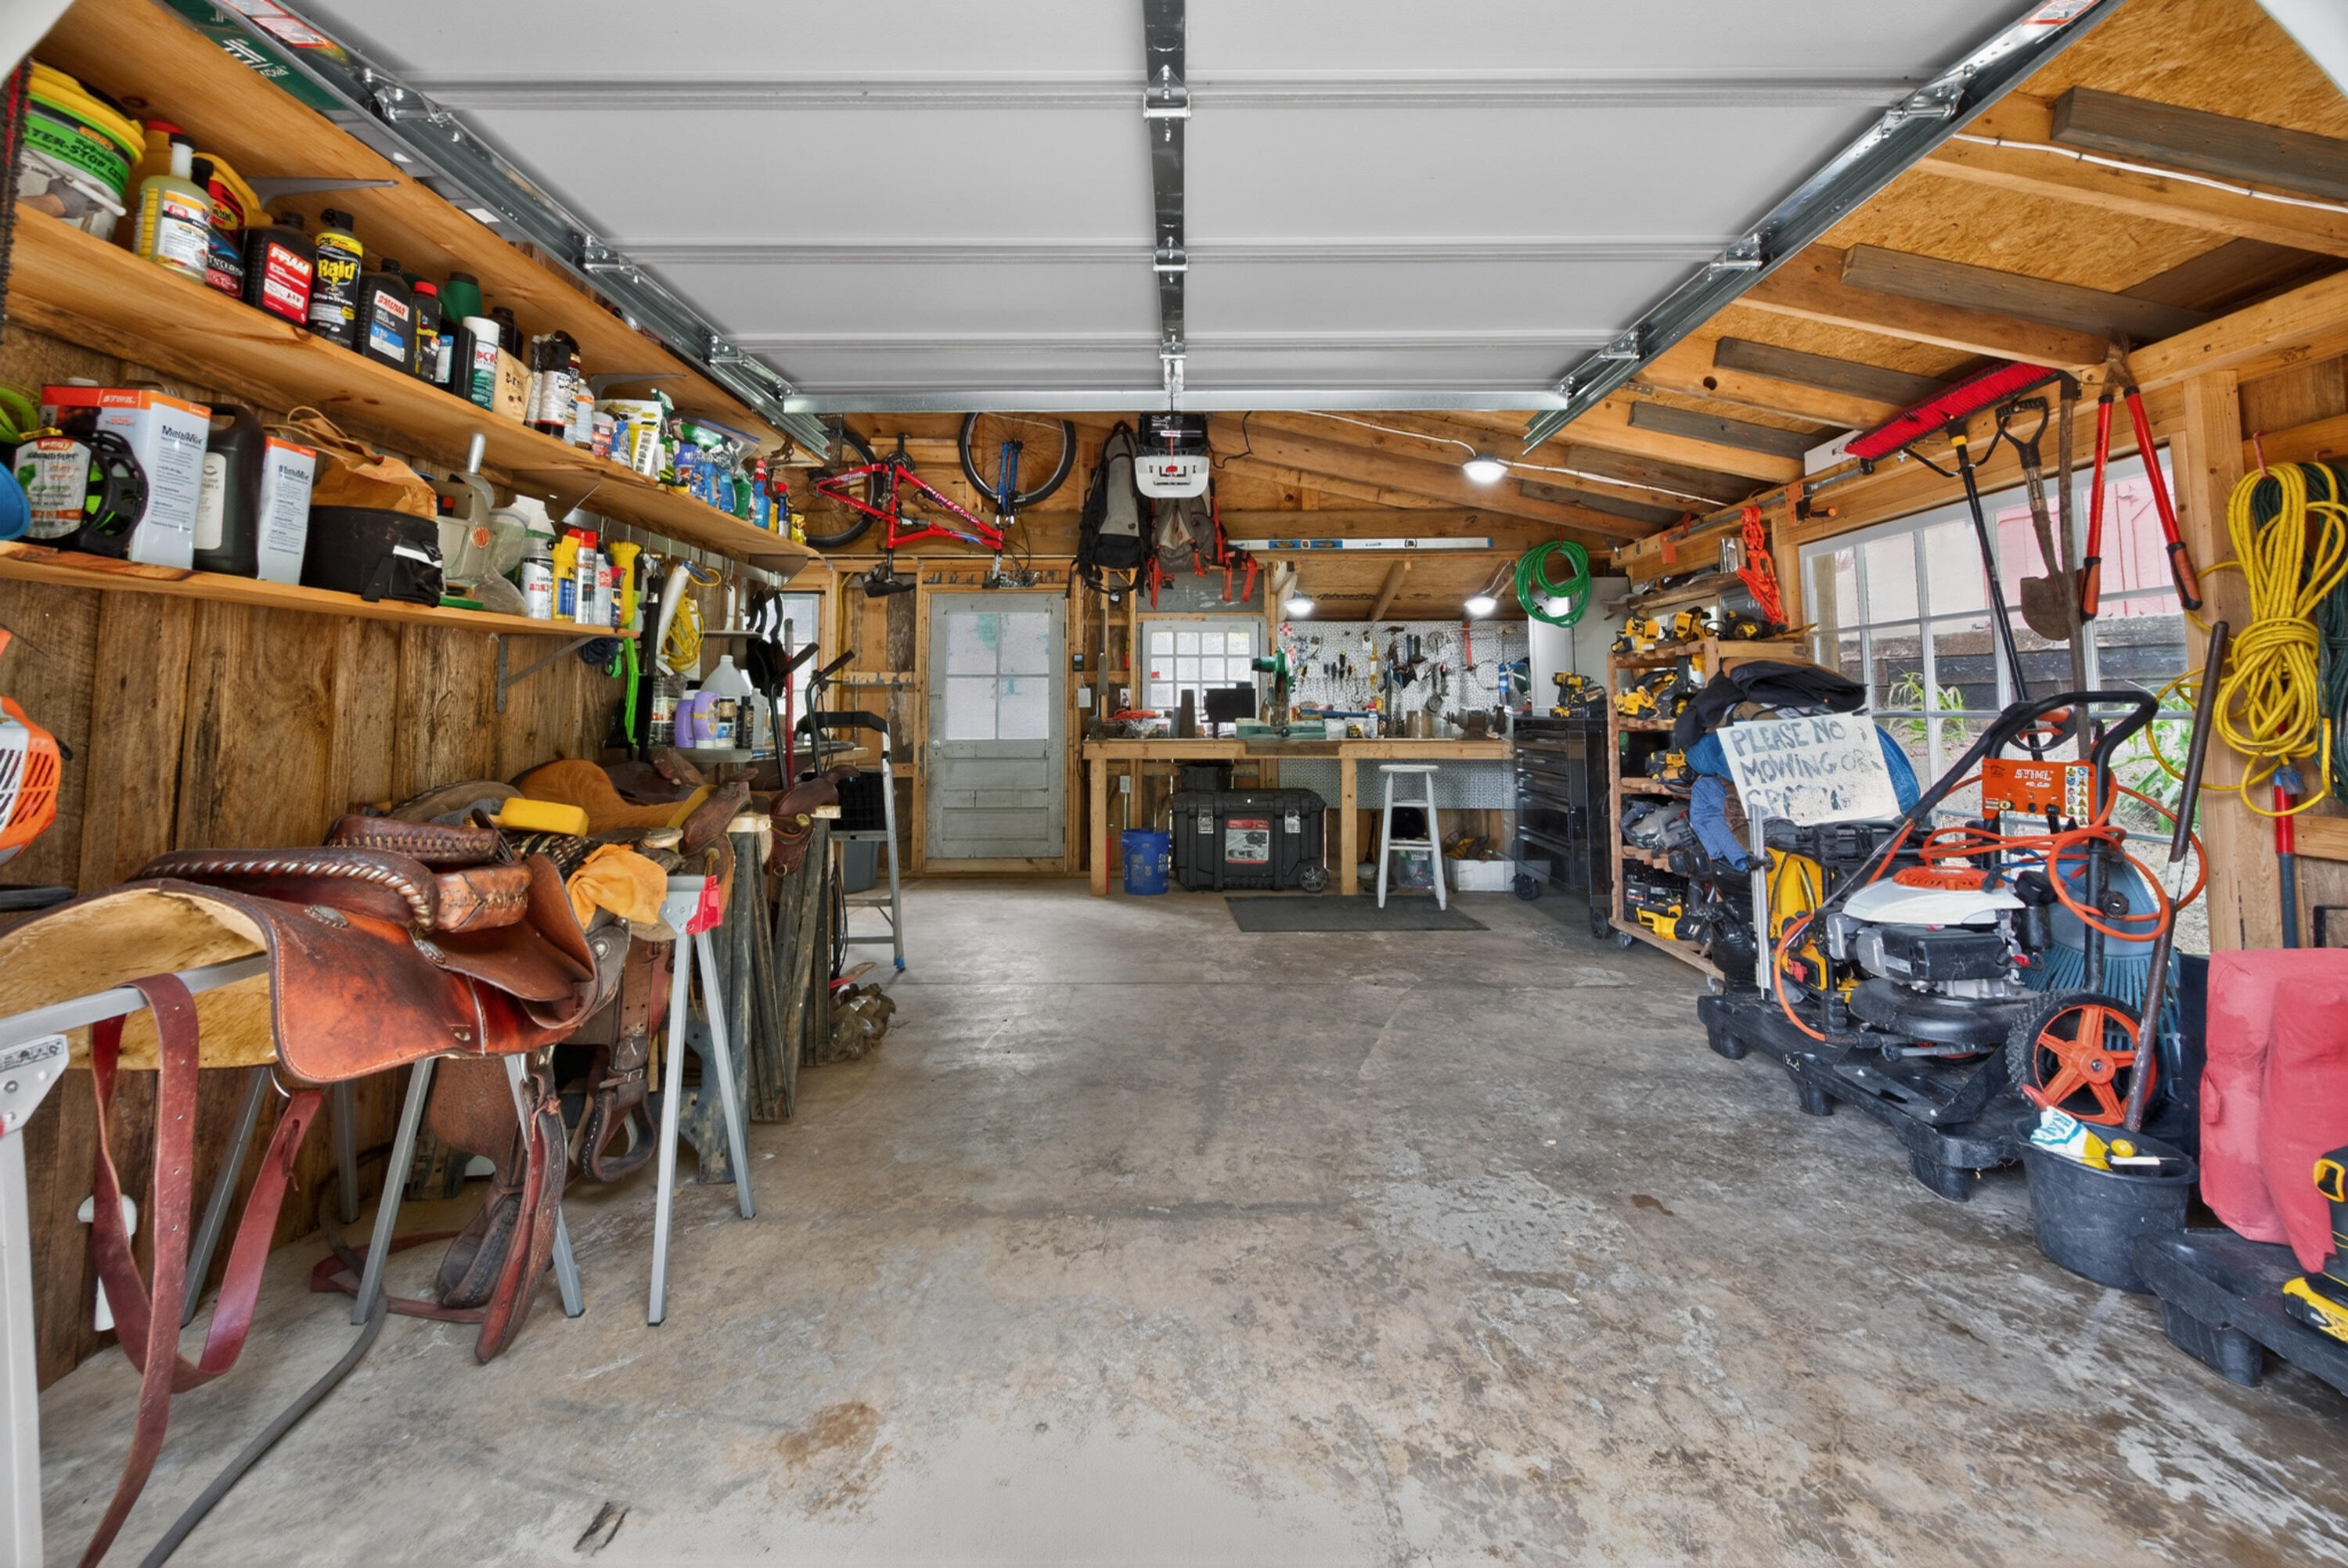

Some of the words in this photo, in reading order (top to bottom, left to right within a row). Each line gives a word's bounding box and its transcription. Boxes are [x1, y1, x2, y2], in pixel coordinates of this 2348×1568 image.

[270, 246, 310, 275] FRAM
[318, 259, 357, 281] Raid
[1729, 722, 1809, 757] PLEASE
[1810, 718, 1846, 743] NO
